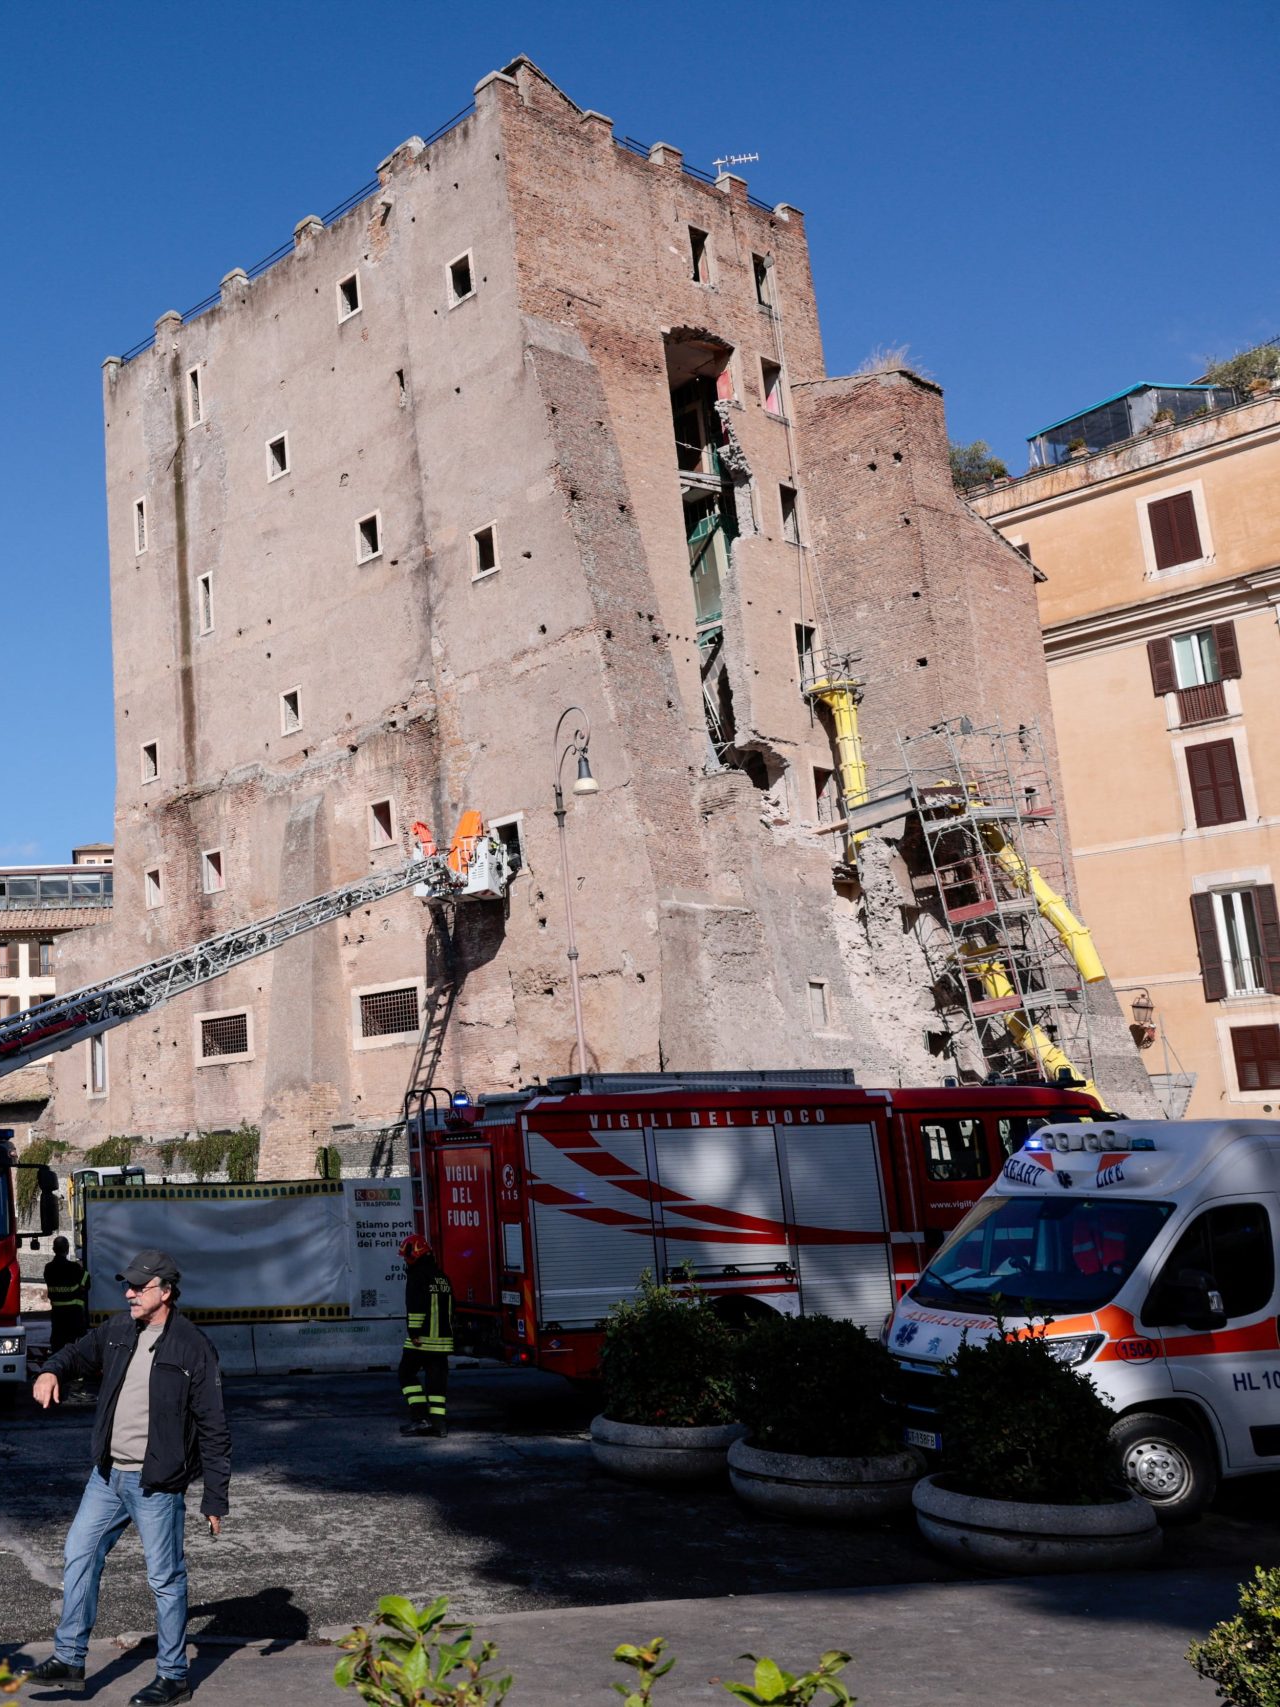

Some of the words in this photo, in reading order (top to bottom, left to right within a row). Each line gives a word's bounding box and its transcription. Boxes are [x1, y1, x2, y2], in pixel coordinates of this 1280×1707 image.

[589, 1112, 672, 1129] VIGILI
[691, 1111, 734, 1126] DEL
[751, 1109, 826, 1125] FUOCO
[445, 1164, 478, 1182] VIGILI
[1002, 1158, 1046, 1187] HEART
[1095, 1162, 1125, 1189] LIFE
[356, 1188, 400, 1200] ROMA
[452, 1187, 472, 1204] DEL
[501, 1190, 519, 1200] 115
[356, 1221, 389, 1229] Stiamo
[392, 1221, 413, 1230] port
[447, 1210, 480, 1227] FUOCO
[356, 1230, 377, 1238] luce
[357, 1240, 373, 1248] dei
[375, 1239, 393, 1248] Fori
[391, 1264, 400, 1272] to
[385, 1273, 394, 1281] of
[1122, 1342, 1153, 1358] 1504
[1233, 1372, 1261, 1391] HL
